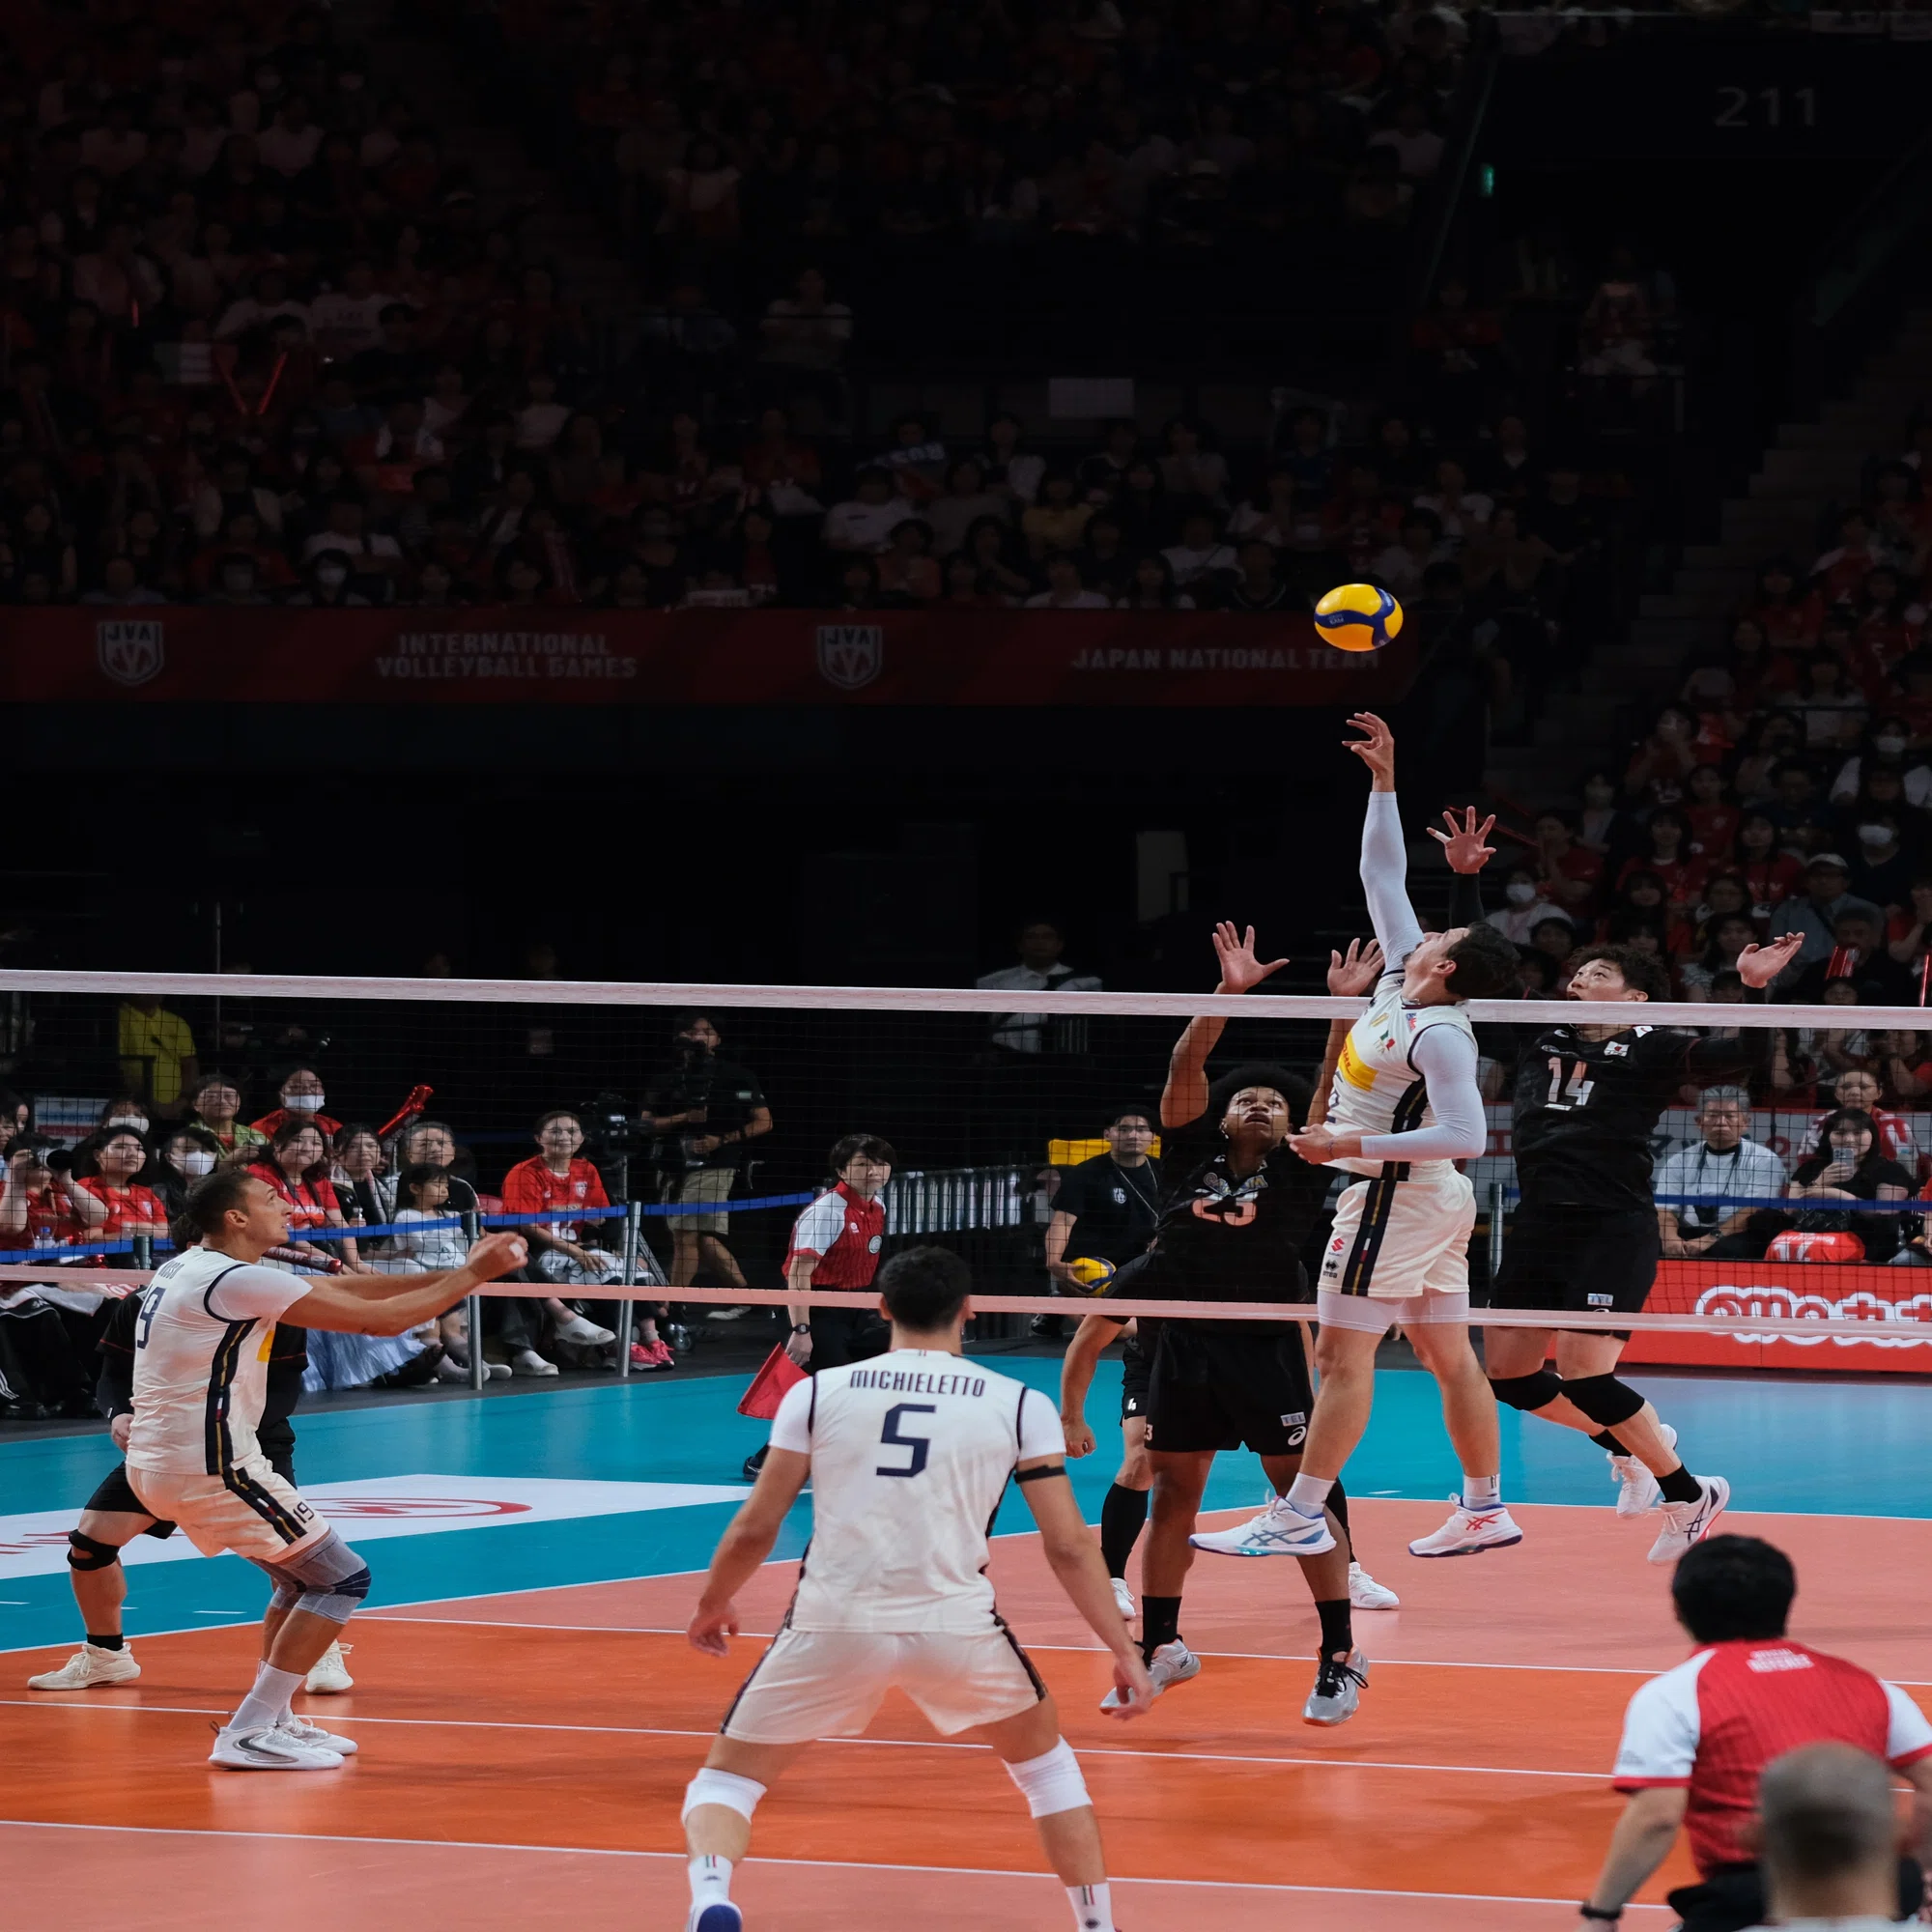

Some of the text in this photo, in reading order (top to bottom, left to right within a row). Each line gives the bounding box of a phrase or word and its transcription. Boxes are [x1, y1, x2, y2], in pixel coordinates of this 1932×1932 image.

[1715, 86, 1816, 127] 211
[108, 625, 151, 640] JVA
[398, 632, 611, 654] INTERNATIONAL
[827, 628, 870, 644] JVA
[376, 657, 638, 680] VOLLEYBALL GAMES
[1071, 648, 1379, 669] JAPAN NATIONAL TEAM
[1548, 1056, 1596, 1106] 14
[136, 1285, 166, 1350] 9
[850, 1370, 986, 1398] MICHIELETTO
[1283, 1413, 1305, 1425] TEL
[876, 1403, 936, 1478] 5
[1144, 1423, 1153, 1441] 3
[293, 1501, 315, 1523] 19
